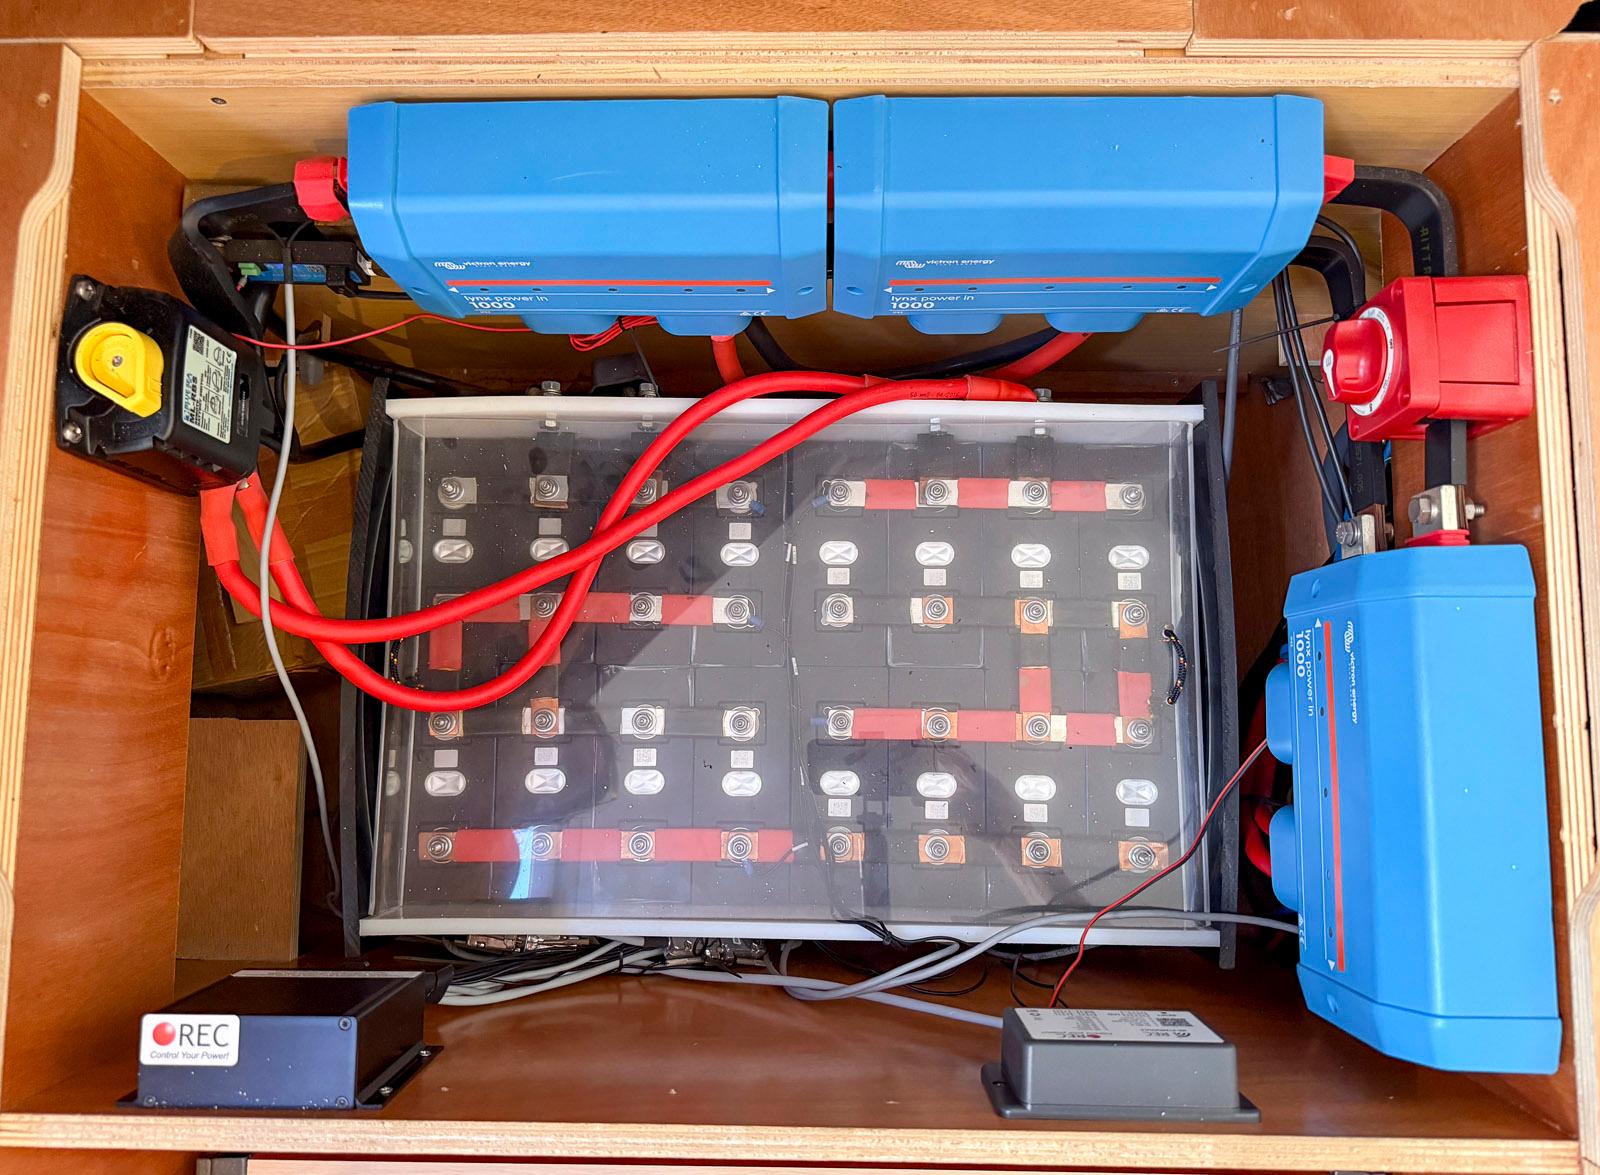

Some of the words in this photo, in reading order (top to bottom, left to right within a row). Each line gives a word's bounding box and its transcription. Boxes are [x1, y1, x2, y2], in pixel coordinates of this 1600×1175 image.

[469, 301, 516, 309] 1000
[891, 301, 935, 309] 1000
[189, 375, 198, 424] ML-RBS
[1296, 630, 1306, 678] 1000
[1304, 629, 1312, 657] lynx
[1305, 661, 1313, 700] power
[1308, 705, 1314, 717] in
[179, 1023, 230, 1047] REC
[150, 1050, 180, 1060] Control
[181, 1050, 199, 1060] Your
[200, 1050, 230, 1060] Power!
